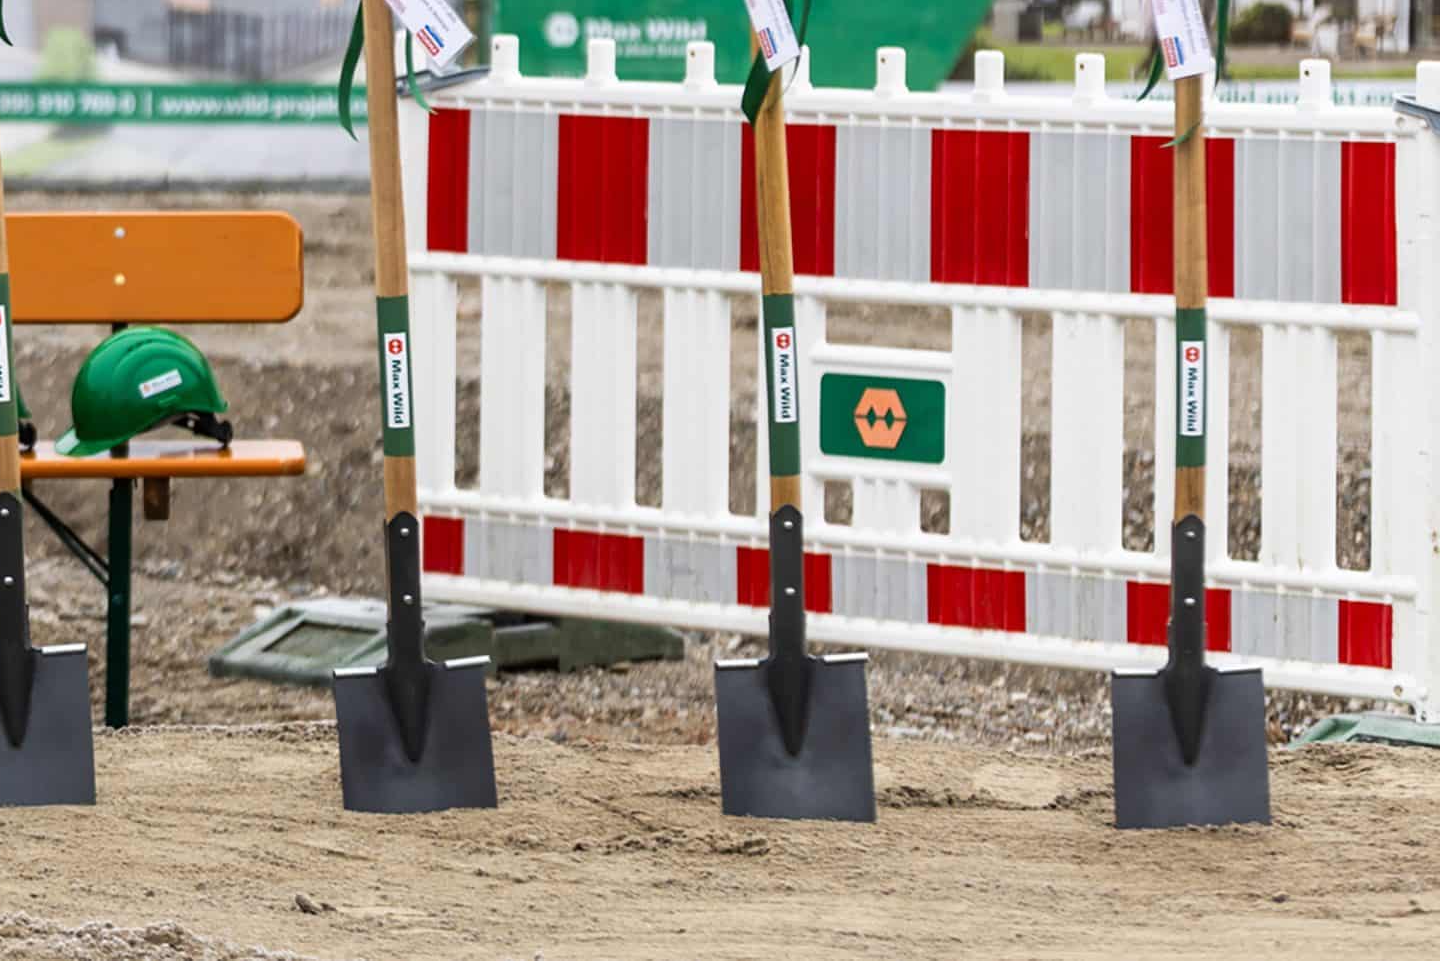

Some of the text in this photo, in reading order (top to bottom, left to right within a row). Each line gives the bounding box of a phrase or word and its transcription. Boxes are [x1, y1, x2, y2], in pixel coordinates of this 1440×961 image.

[392, 360, 404, 424] Max Wild
[779, 354, 791, 418] Max Wild
[1187, 367, 1197, 432] Max Wild
